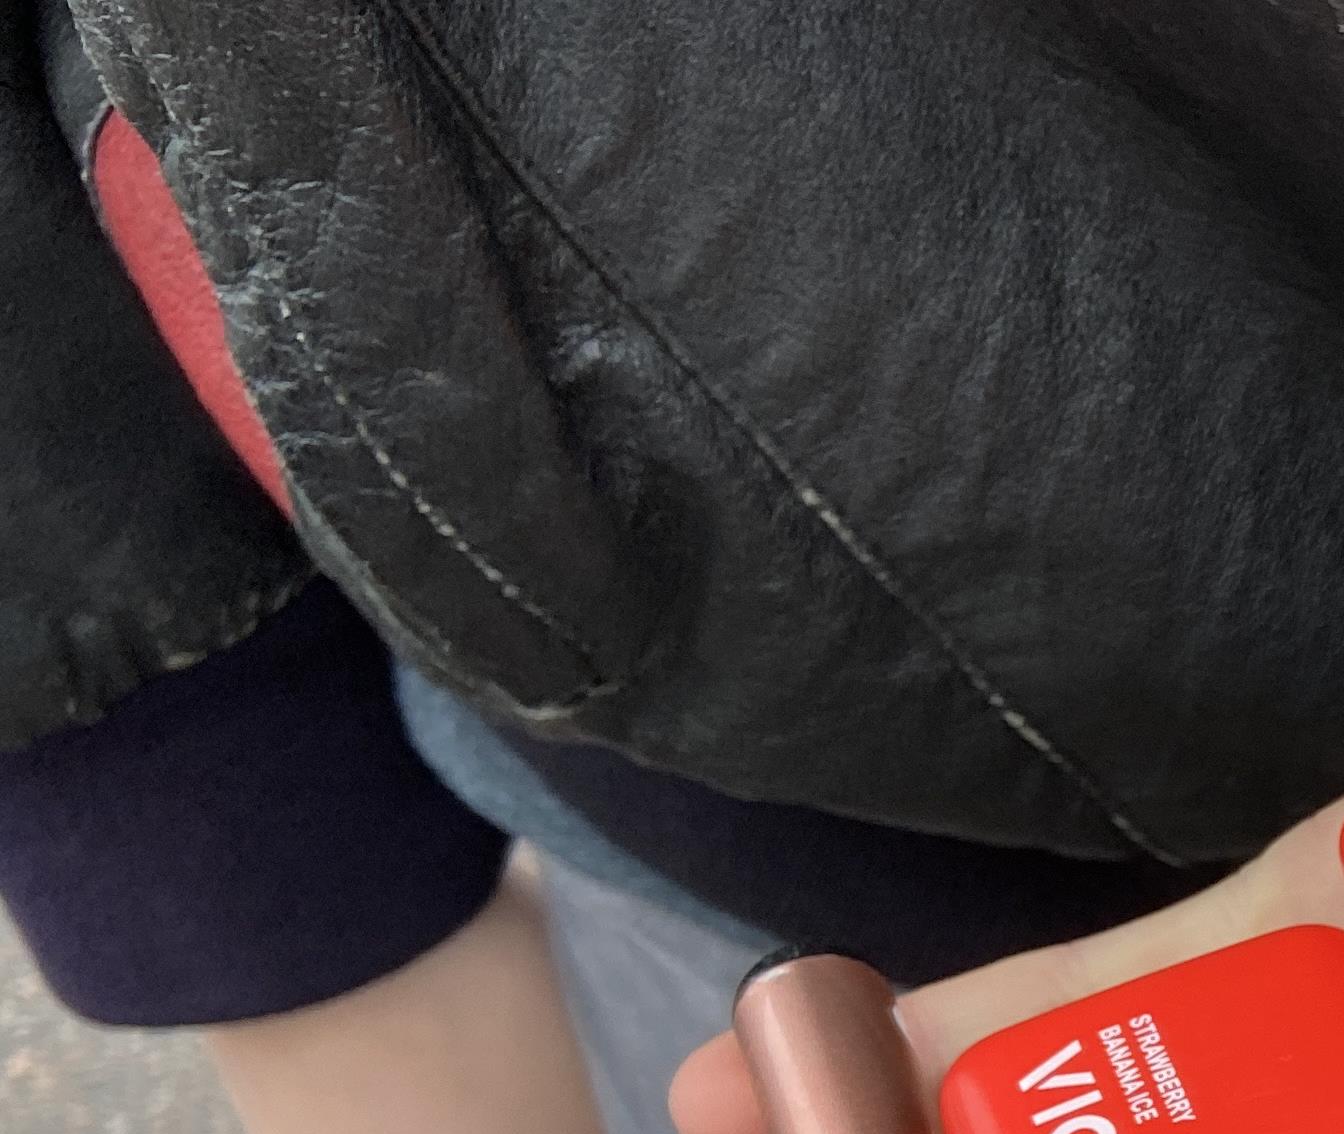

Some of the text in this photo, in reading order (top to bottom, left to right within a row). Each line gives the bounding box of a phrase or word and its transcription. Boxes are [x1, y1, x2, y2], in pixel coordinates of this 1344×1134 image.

[1098, 1023, 1160, 1125] BANANA ICE
[1128, 1013, 1197, 1124] STRAWBERRY
